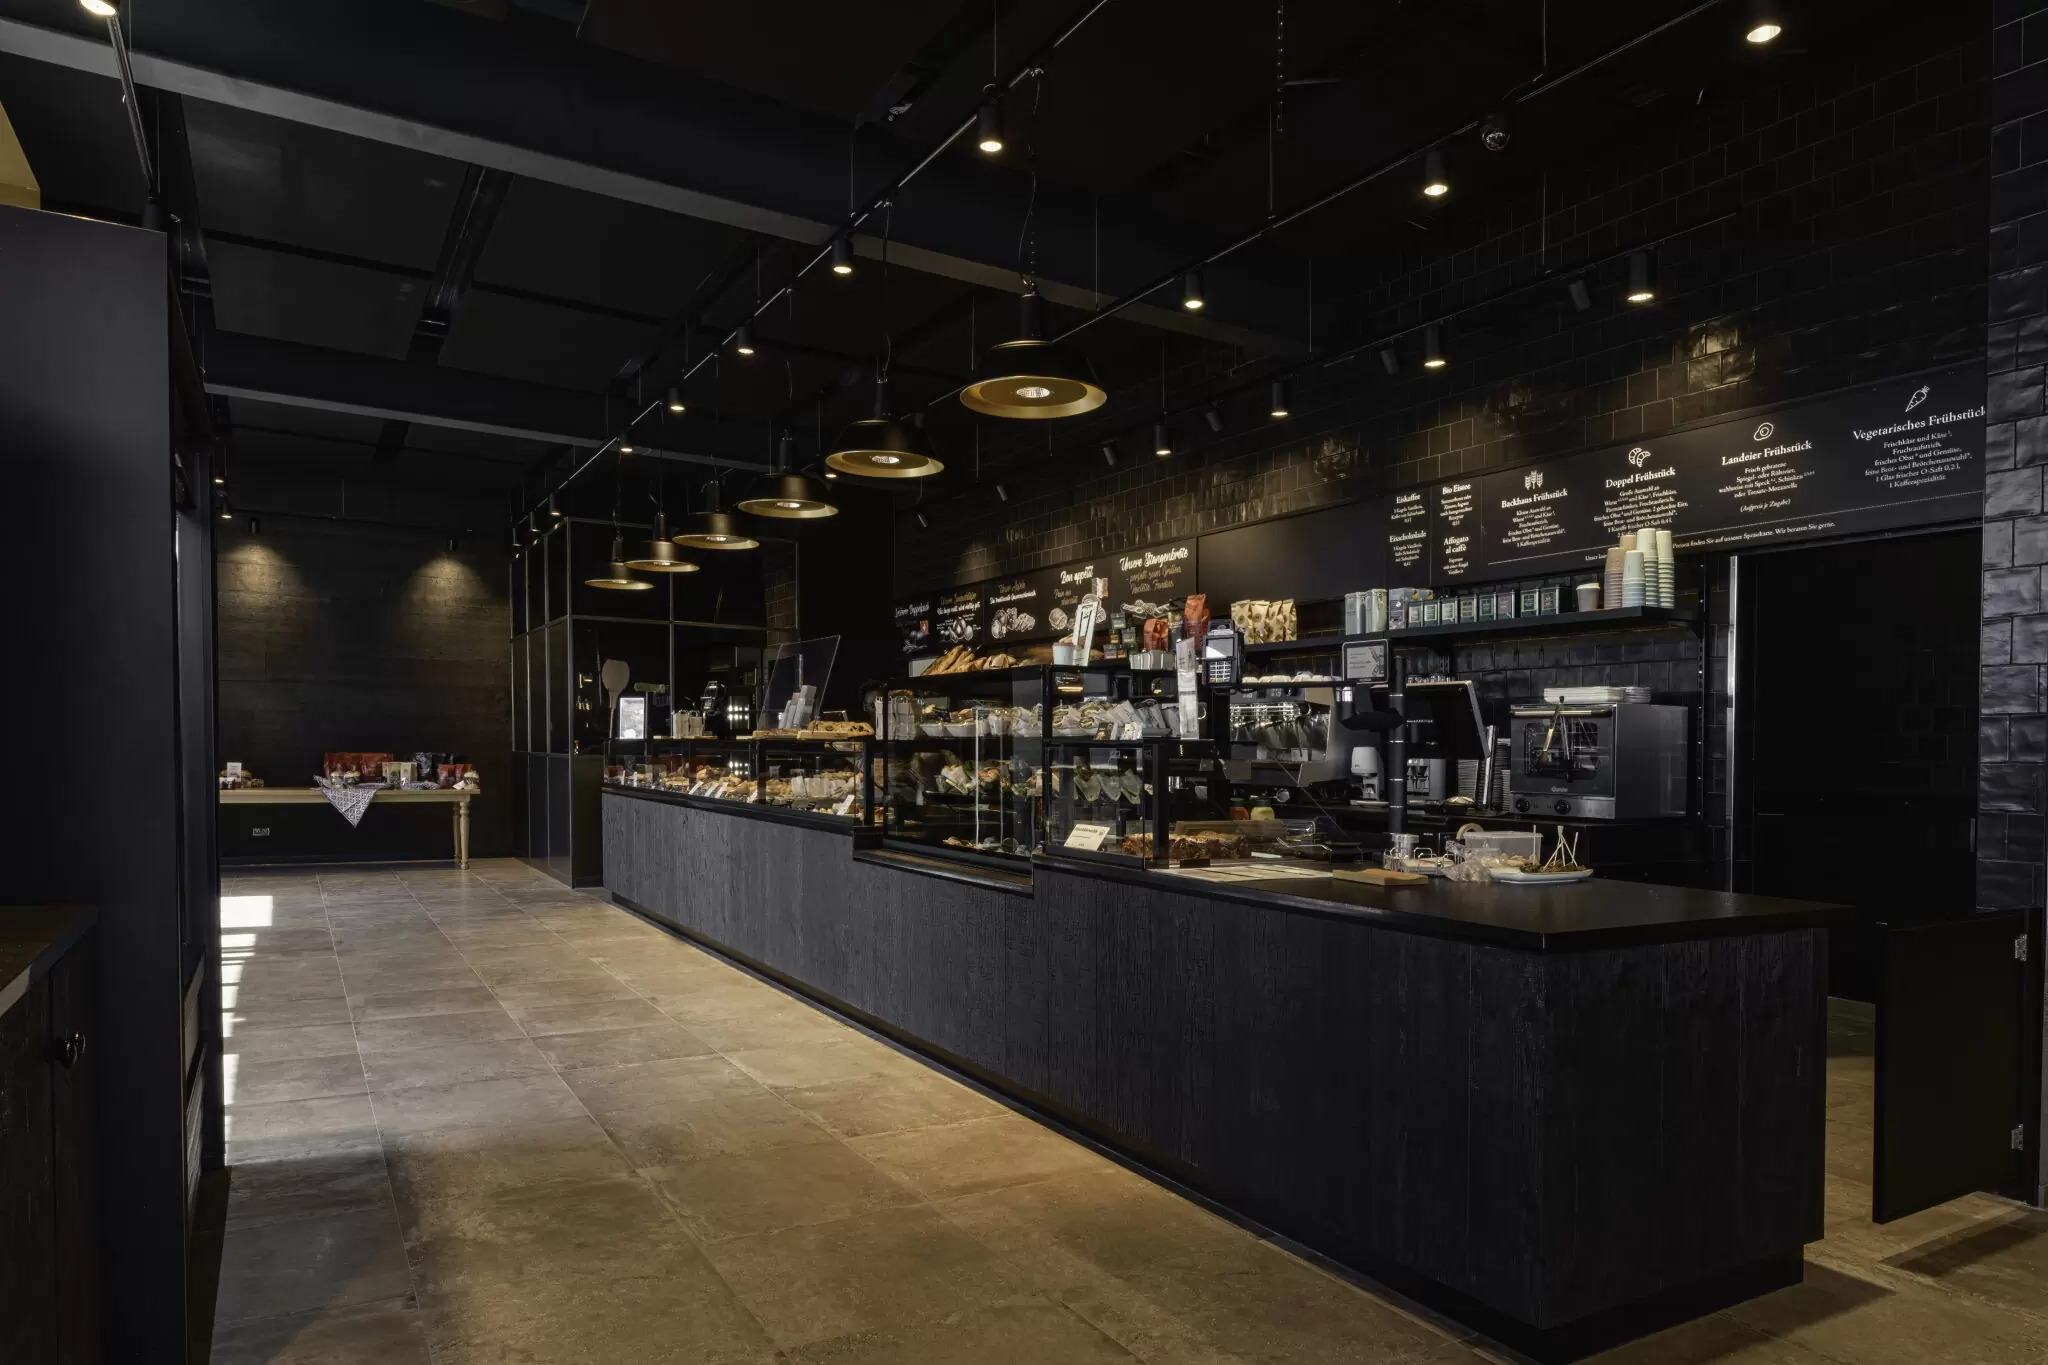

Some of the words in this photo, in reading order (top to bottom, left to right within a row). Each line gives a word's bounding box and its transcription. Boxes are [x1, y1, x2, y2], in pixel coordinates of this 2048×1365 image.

[1853, 420, 1925, 440] Vegetarisches
[1721, 452, 1762, 466] Landeier
[1764, 440, 1812, 458] Frühstück
[1606, 475, 1634, 488] Doppel
[1635, 467, 1676, 482] Frühstück
[1453, 484, 1471, 492] Eistee
[1396, 493, 1420, 504] Eiskaffee
[1501, 496, 1532, 508] Backhaus
[1533, 488, 1568, 502] Frühstück
[1389, 530, 1427, 542] Eisschokolade
[1444, 536, 1469, 545] Affogato
[1120, 557, 1142, 571] Unsere
[1061, 571, 1073, 584] Bon
